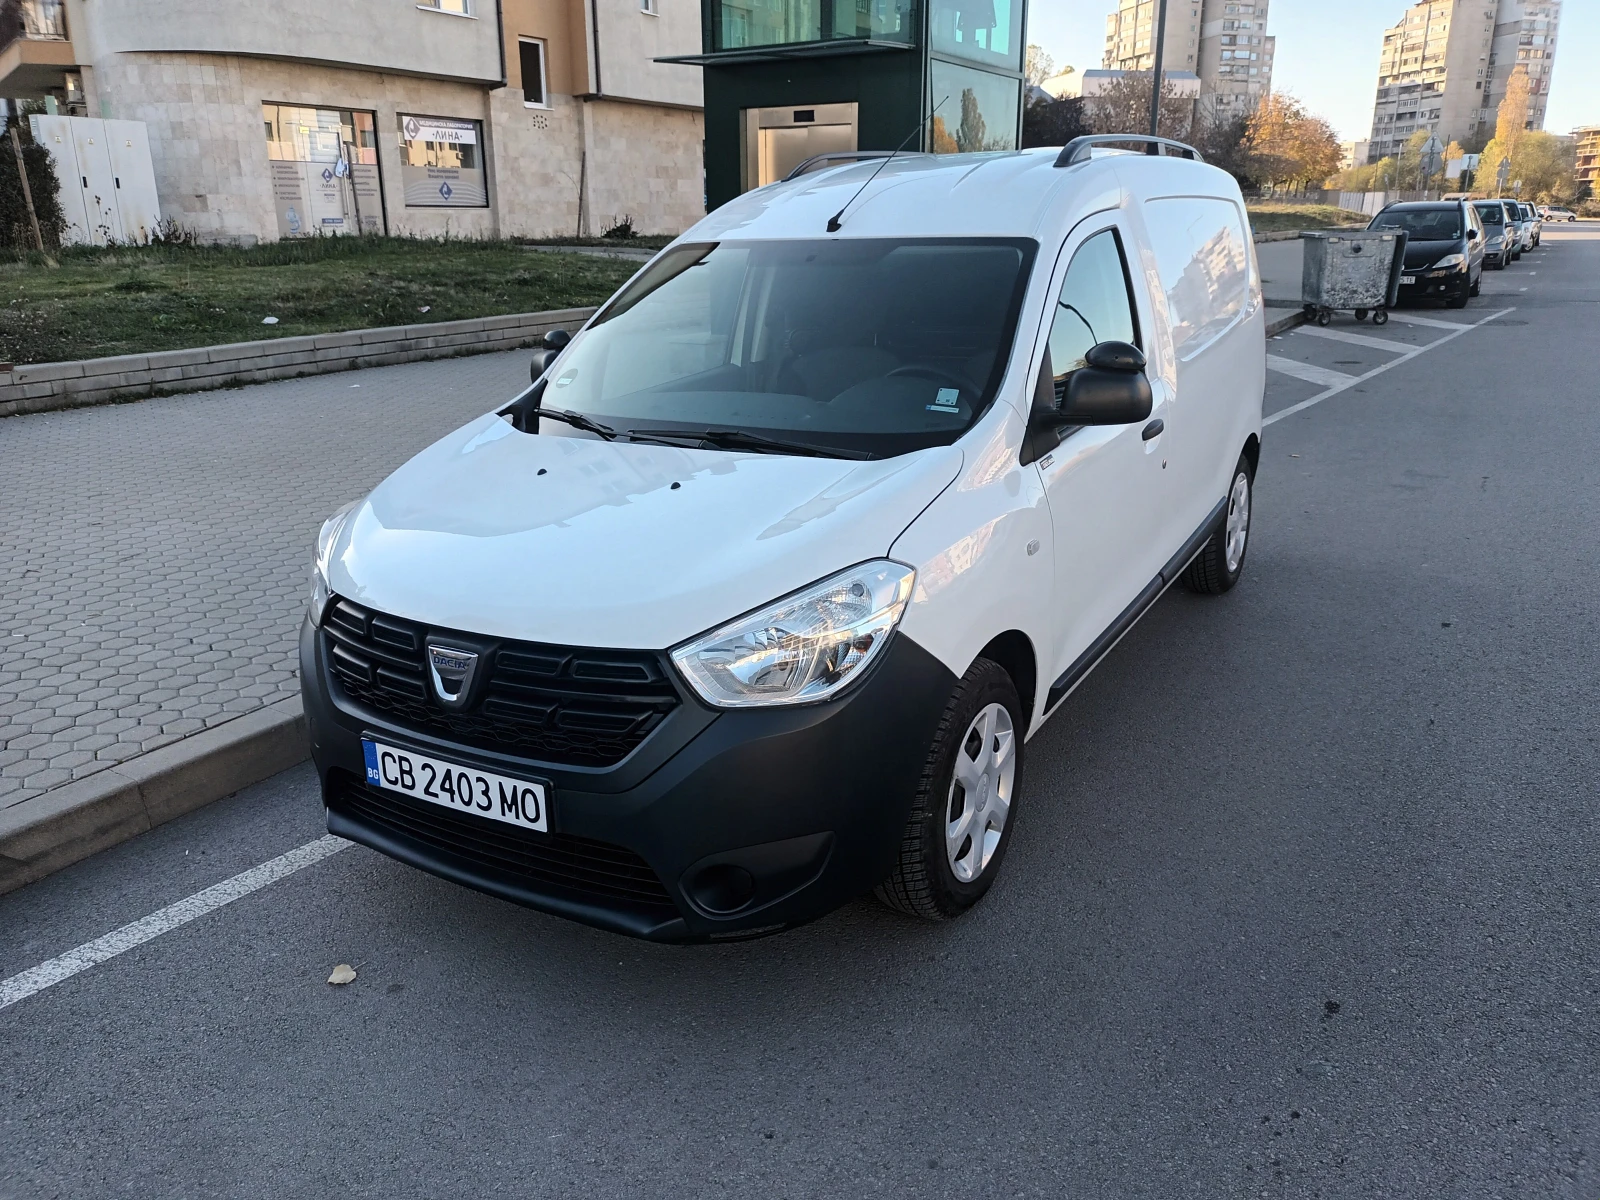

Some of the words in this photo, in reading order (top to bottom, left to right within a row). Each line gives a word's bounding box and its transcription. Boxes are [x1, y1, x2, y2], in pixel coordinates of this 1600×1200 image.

[419, 120, 447, 128] МЕДИЦИНСКА
[433, 656, 466, 670] DACIA
[367, 767, 379, 780] BG
[381, 751, 416, 791] CB
[421, 763, 493, 812] 2403
[499, 781, 541, 824] MO
